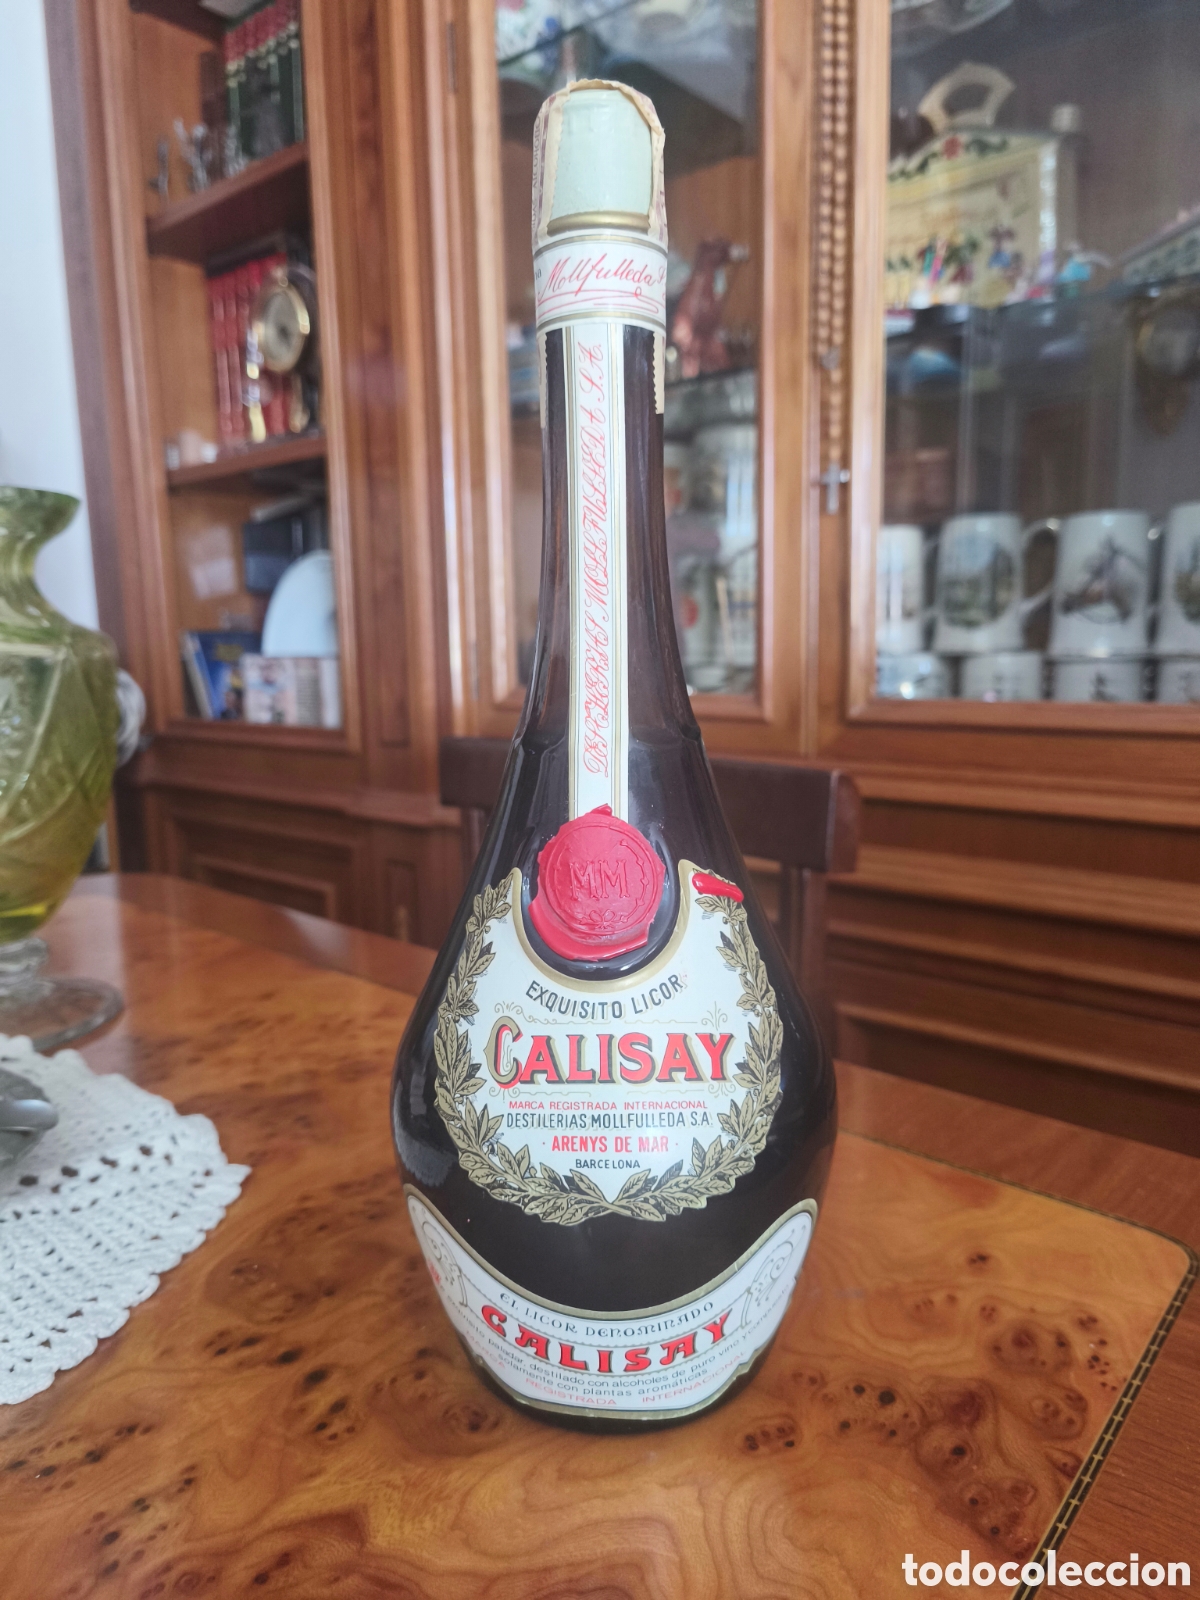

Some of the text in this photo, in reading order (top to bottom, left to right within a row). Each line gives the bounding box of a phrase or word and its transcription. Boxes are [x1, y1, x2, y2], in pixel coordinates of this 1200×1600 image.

[525, 974, 683, 1020] EXQUISITO LICOR
[483, 1015, 735, 1089] CALISAY
[506, 1111, 714, 1129] DESTILERIAS MOLLFULLEDA S.A.
[509, 1100, 708, 1110] MARCA REGISTRADA INTERNACIONAL
[551, 1135, 669, 1153] ARENYS DE MAR
[575, 1158, 641, 1170] BARCELONA
[500, 1292, 519, 1310] EL
[525, 1307, 578, 1334] LICOR
[481, 1304, 733, 1373] CALISAY
[498, 1354, 554, 1386] solamente
[557, 1382, 579, 1393] con
[583, 1387, 632, 1397] plantas
[525, 1377, 617, 1406] REGISTRADA
[642, 1351, 744, 1403] INTERNACIONAL
[529, 1363, 585, 1386] destilado
[587, 1380, 609, 1388] con
[612, 1374, 669, 1388] alcoholes
[671, 1369, 686, 1379] de
[690, 1355, 716, 1373] puro
[718, 1339, 740, 1356] vino
